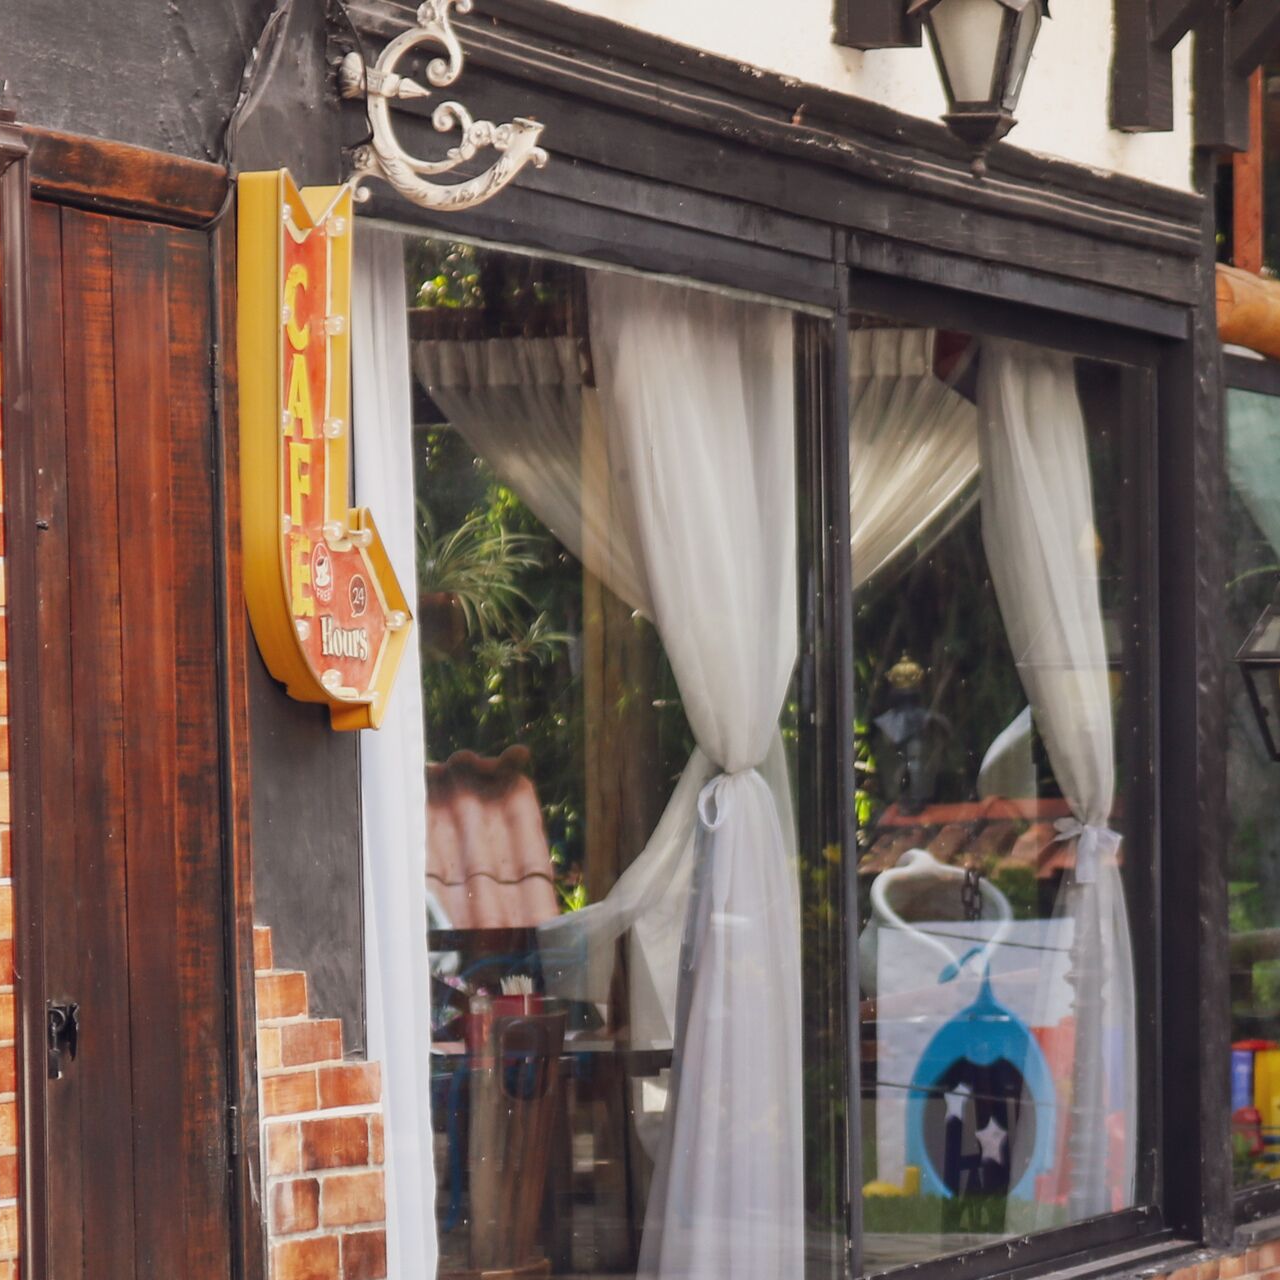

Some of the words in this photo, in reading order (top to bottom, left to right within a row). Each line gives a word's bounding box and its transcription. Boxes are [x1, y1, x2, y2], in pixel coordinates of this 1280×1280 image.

[284, 263, 315, 617] CAFE
[352, 587, 365, 605] 24
[320, 615, 369, 661] Hours
